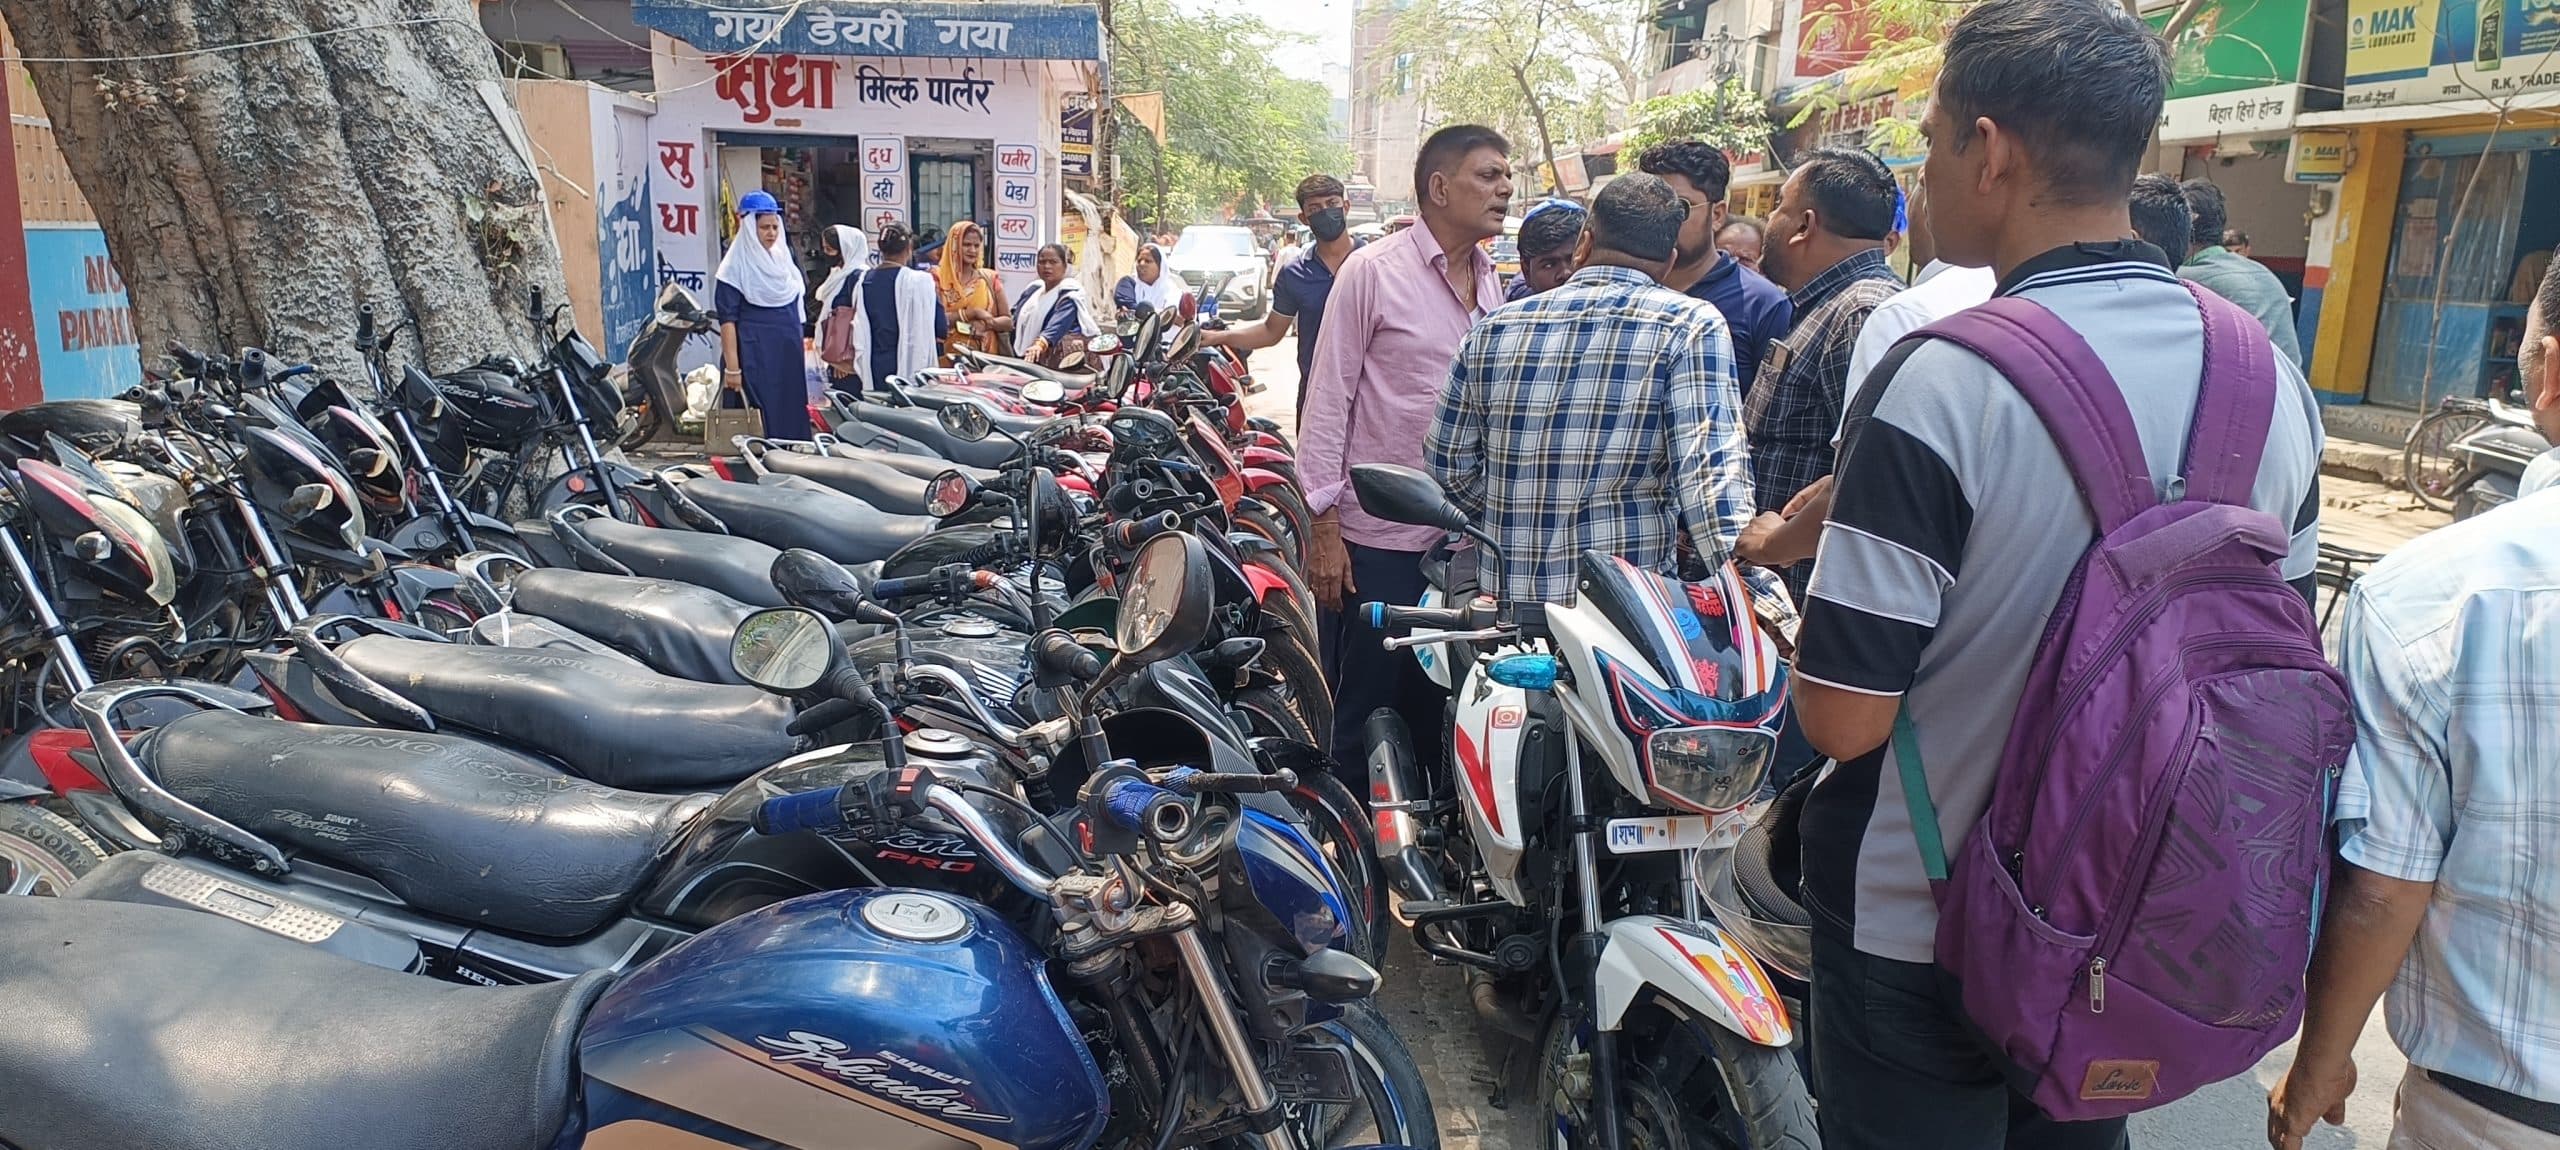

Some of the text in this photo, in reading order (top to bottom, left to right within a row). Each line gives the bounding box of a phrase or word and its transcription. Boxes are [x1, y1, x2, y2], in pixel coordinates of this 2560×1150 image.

[709, 6, 1013, 51] गया डेयरी गया
[2369, 6, 2416, 35] MAK
[2368, 32, 2416, 48] LUBRICANTS
[705, 54, 841, 124] सुधा
[855, 64, 995, 115] मिल्क पार्लर
[2491, 77, 2515, 91] R.K.
[2208, 103, 2233, 124] बिहार
[2315, 146, 2340, 155] MAK
[872, 178, 895, 202] दही
[59, 308, 138, 352] PARKI
[876, 850, 977, 873] PRO
[755, 1030, 1014, 1124] Splendor
